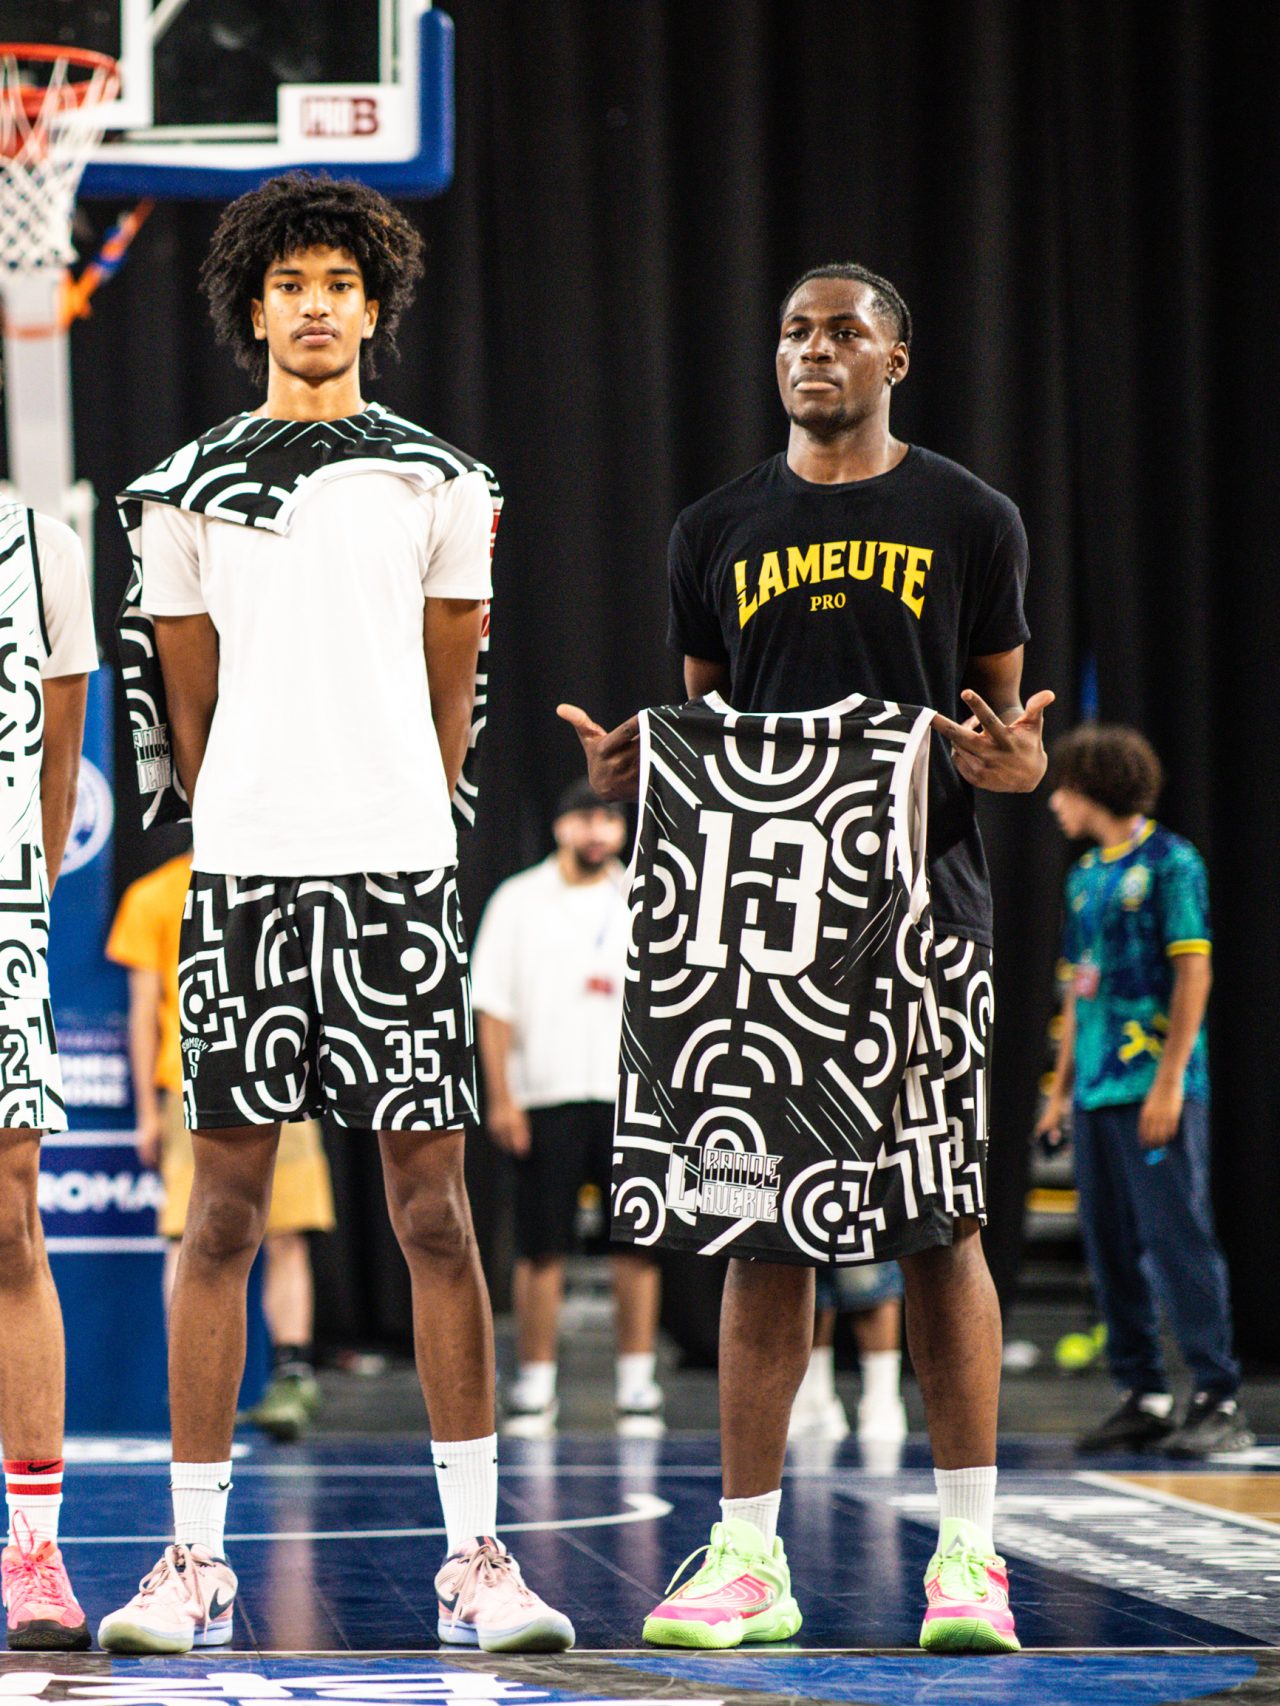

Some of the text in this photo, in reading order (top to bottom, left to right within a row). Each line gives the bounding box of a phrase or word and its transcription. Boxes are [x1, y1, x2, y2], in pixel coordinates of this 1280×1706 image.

[734, 540, 934, 630] LAMEUTE
[809, 592, 847, 612] PRO
[686, 808, 828, 977] 13
[1, 1032, 29, 1086] 2
[181, 1036, 209, 1053] SAMSEY
[384, 1030, 441, 1083] 35
